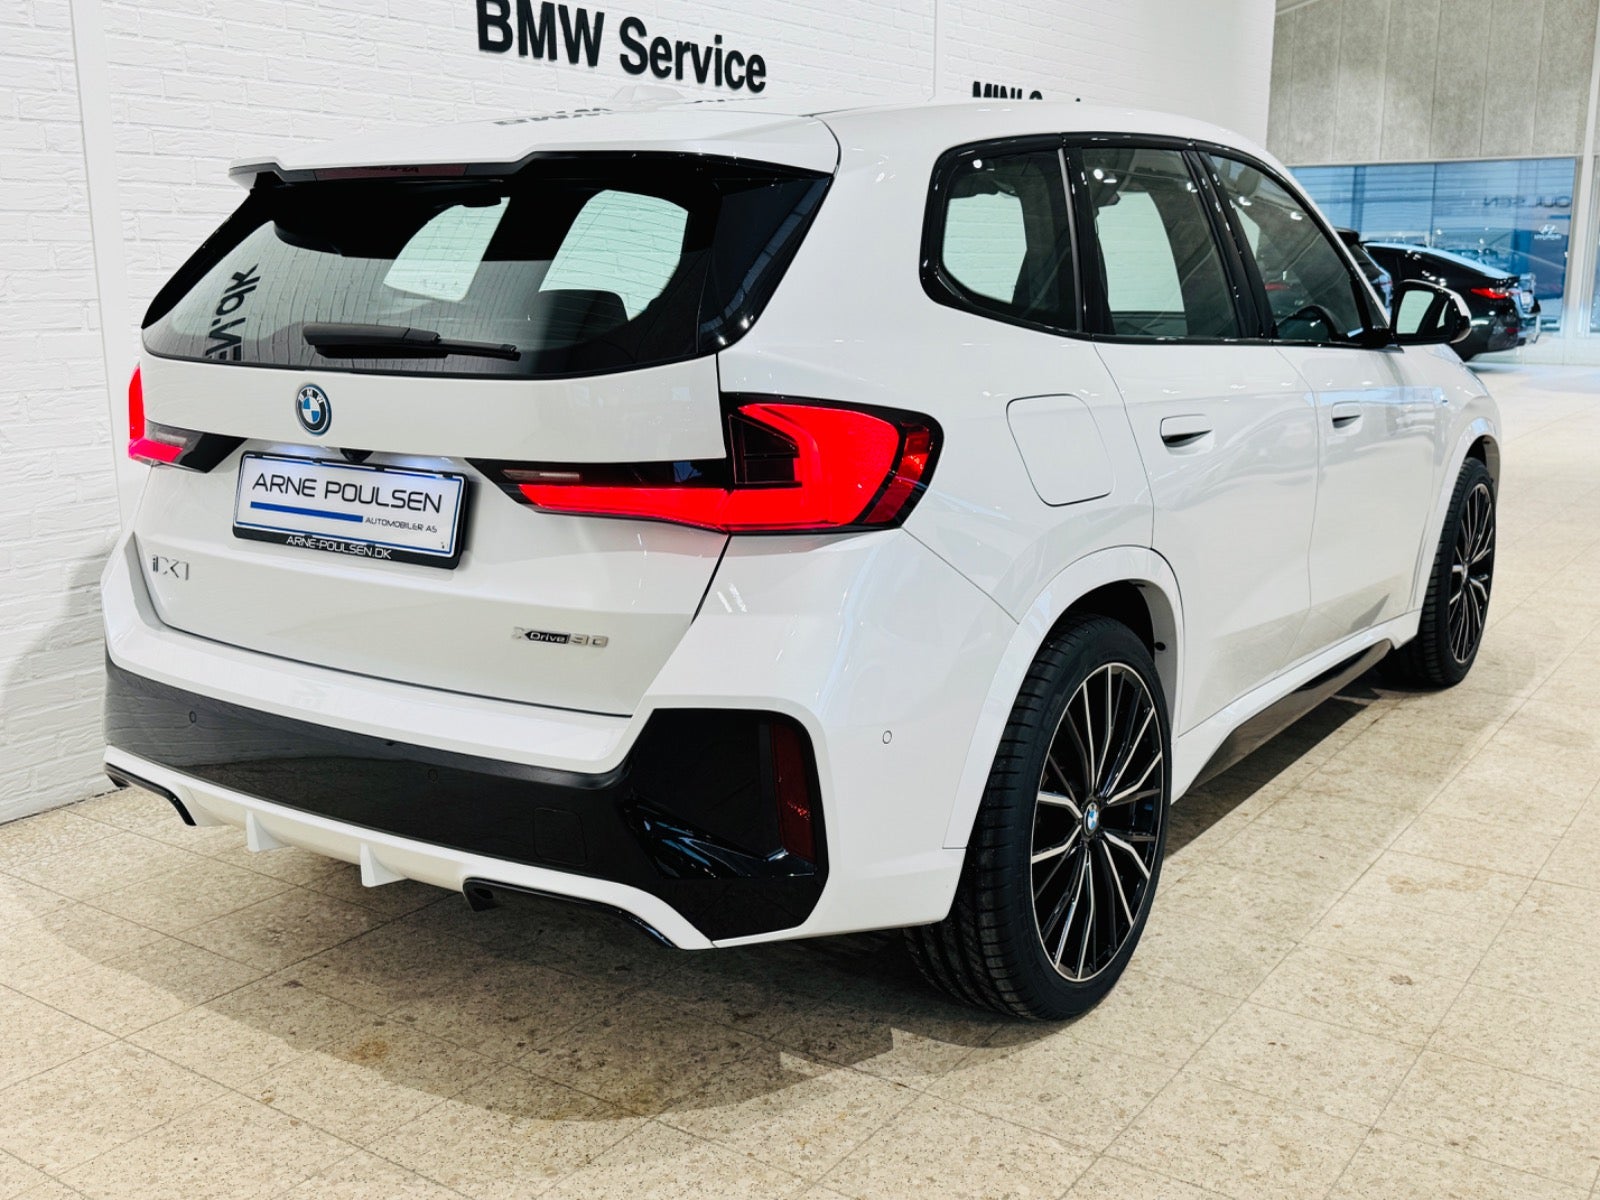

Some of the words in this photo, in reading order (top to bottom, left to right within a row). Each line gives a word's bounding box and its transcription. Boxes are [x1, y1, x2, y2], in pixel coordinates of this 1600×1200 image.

[477, 0, 605, 67] BMW
[619, 17, 767, 94] Service
[252, 472, 317, 497] ARNE
[324, 480, 442, 514] POULSEN
[365, 516, 424, 532] AUTOMOBILER
[426, 524, 438, 533] AS
[286, 535, 392, 560] ARNE-POULSEN.DK
